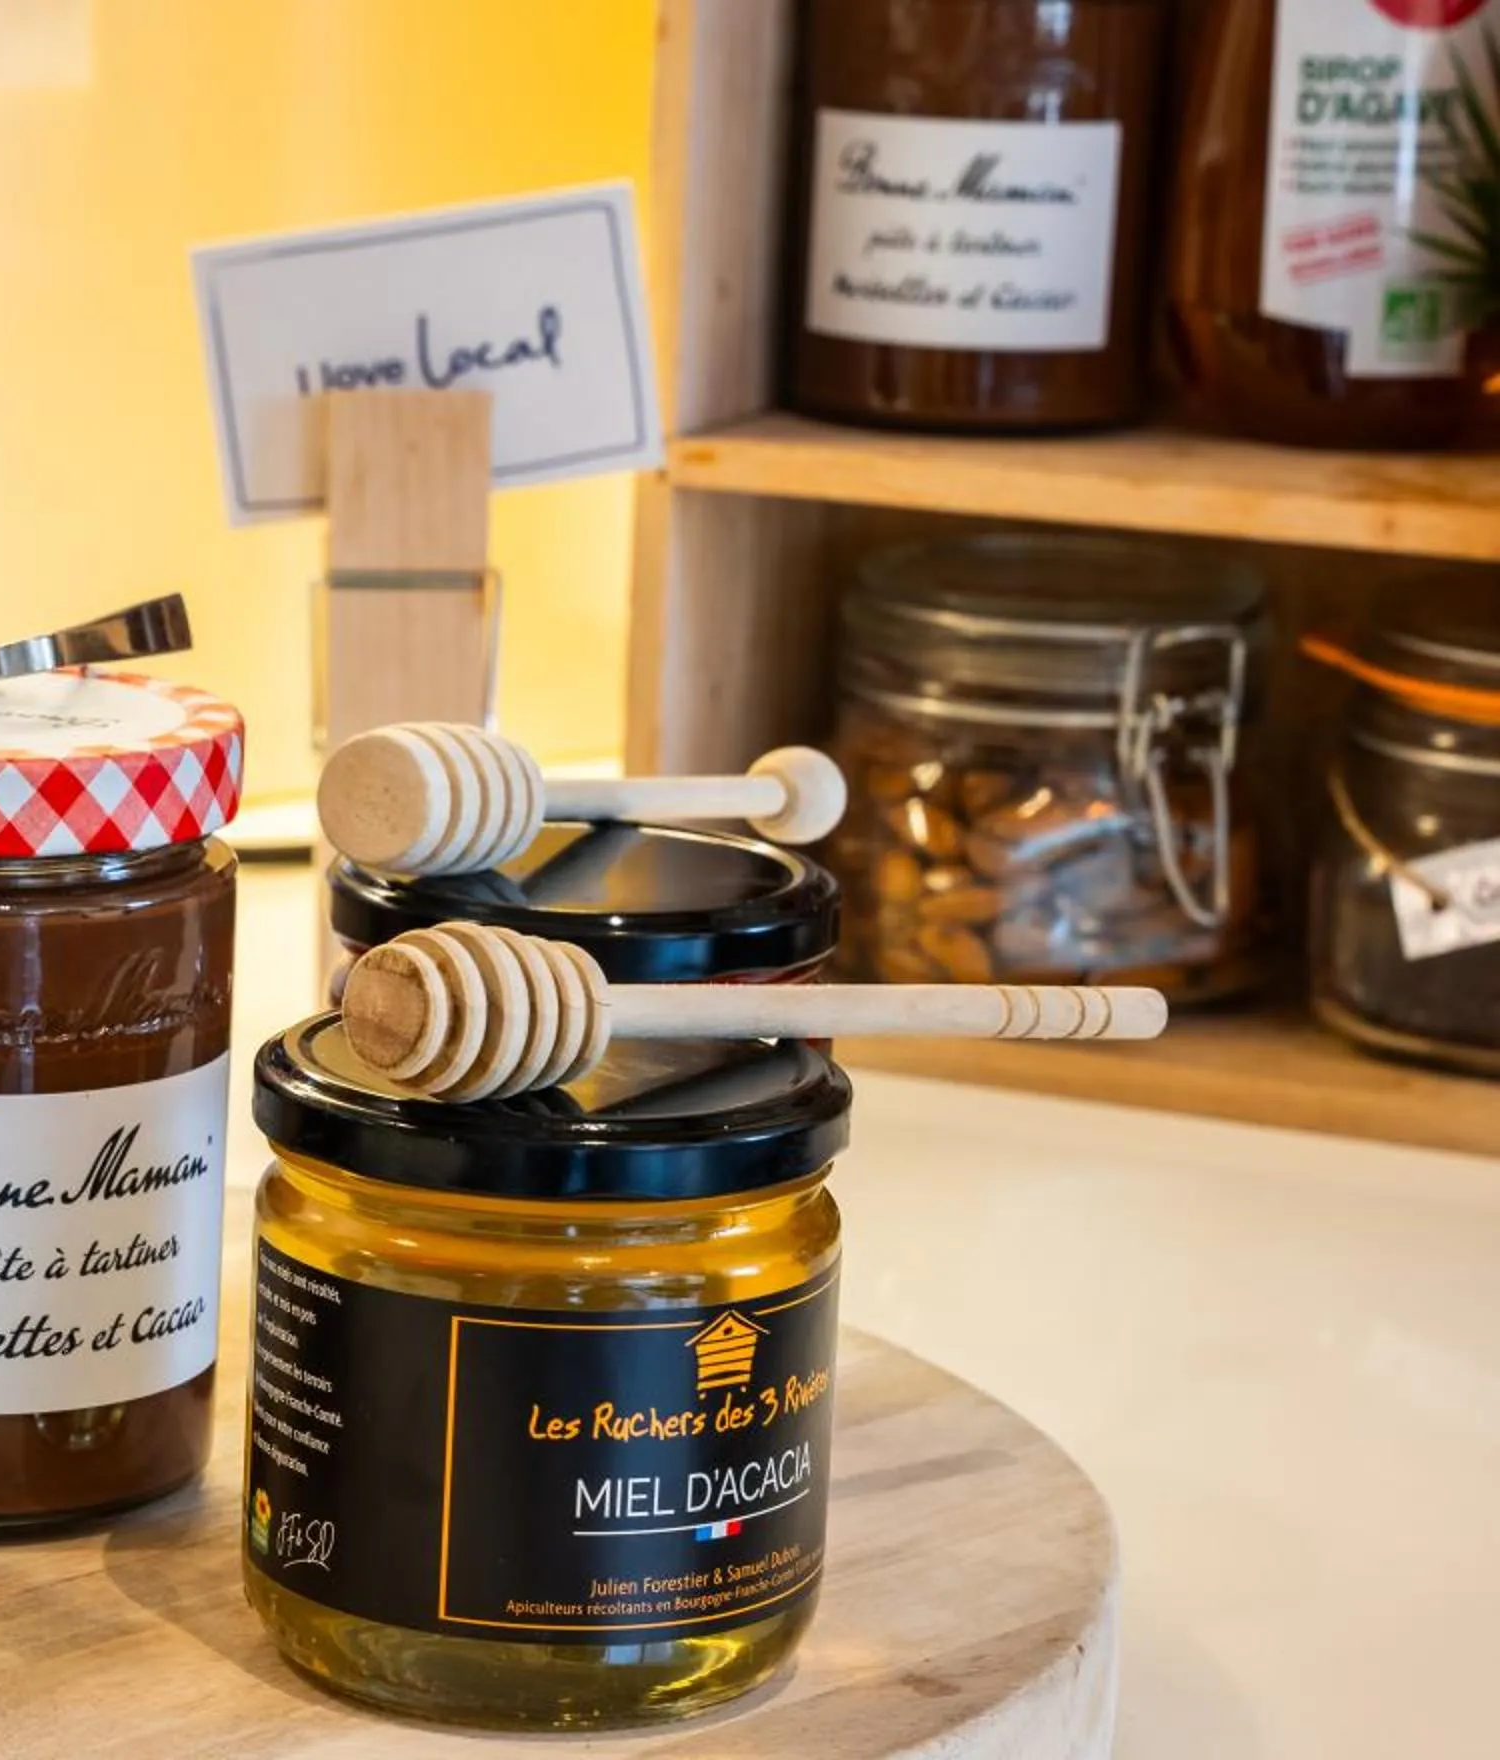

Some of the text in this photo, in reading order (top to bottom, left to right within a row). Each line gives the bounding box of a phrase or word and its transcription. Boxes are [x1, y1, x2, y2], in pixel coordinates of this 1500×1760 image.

[1302, 56, 1403, 80] SIROP
[296, 367, 311, 397] I
[61, 1123, 208, 1204] Maman
[44, 1248, 70, 1281] à
[79, 1231, 181, 1278] tartiner
[91, 1312, 126, 1352] et
[529, 1404, 581, 1440] Les
[592, 1401, 707, 1442] Ruchers
[715, 1394, 756, 1434] des
[760, 1388, 779, 1426] 3
[575, 1440, 812, 1519] MIEL D'ACACIA
[590, 1578, 638, 1599] Julien
[643, 1567, 709, 1594] Forestier
[713, 1567, 724, 1585] &
[726, 1554, 769, 1583] Samuel
[506, 1598, 584, 1617] Apiculteurs
[587, 1598, 654, 1616] récoltants
[656, 1599, 671, 1612] en
